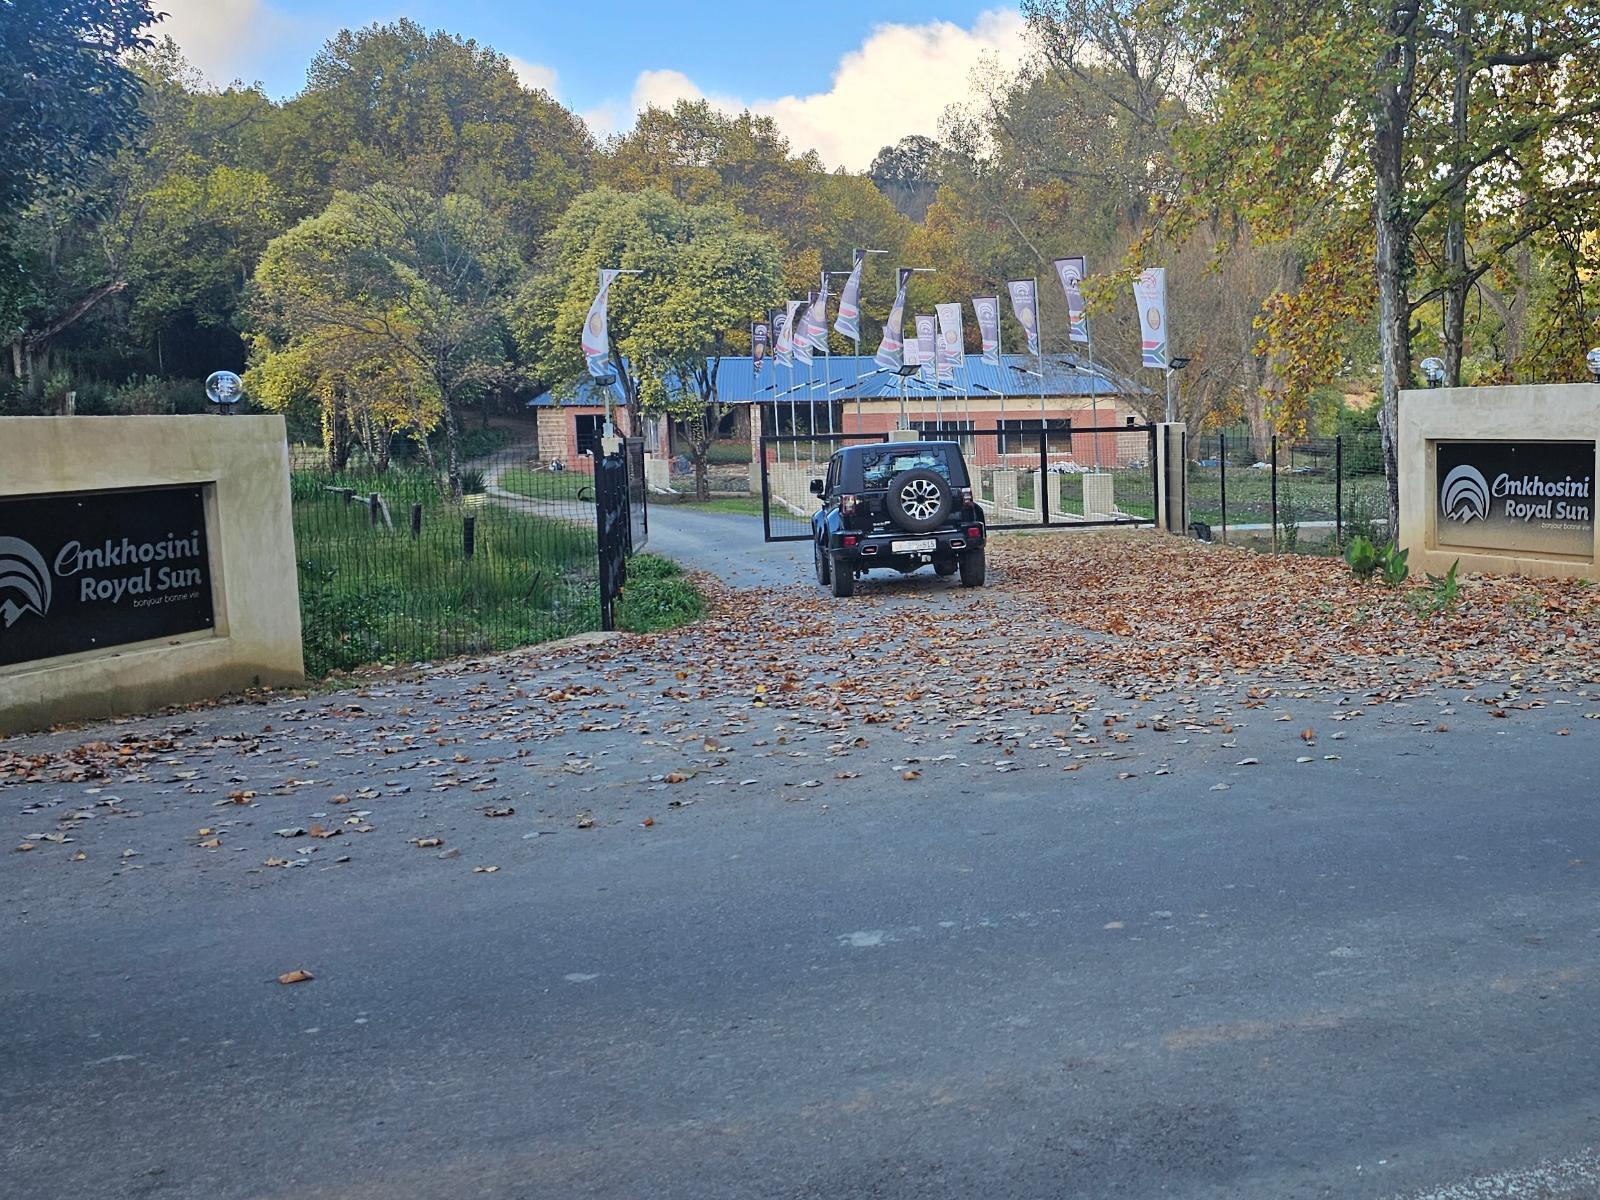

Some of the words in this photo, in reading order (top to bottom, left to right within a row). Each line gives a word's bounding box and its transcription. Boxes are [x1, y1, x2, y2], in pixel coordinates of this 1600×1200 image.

[1506, 499, 1552, 522] Royal
[1556, 502, 1589, 520] Sun
[80, 567, 152, 603] Royal
[157, 566, 202, 590] Sun
